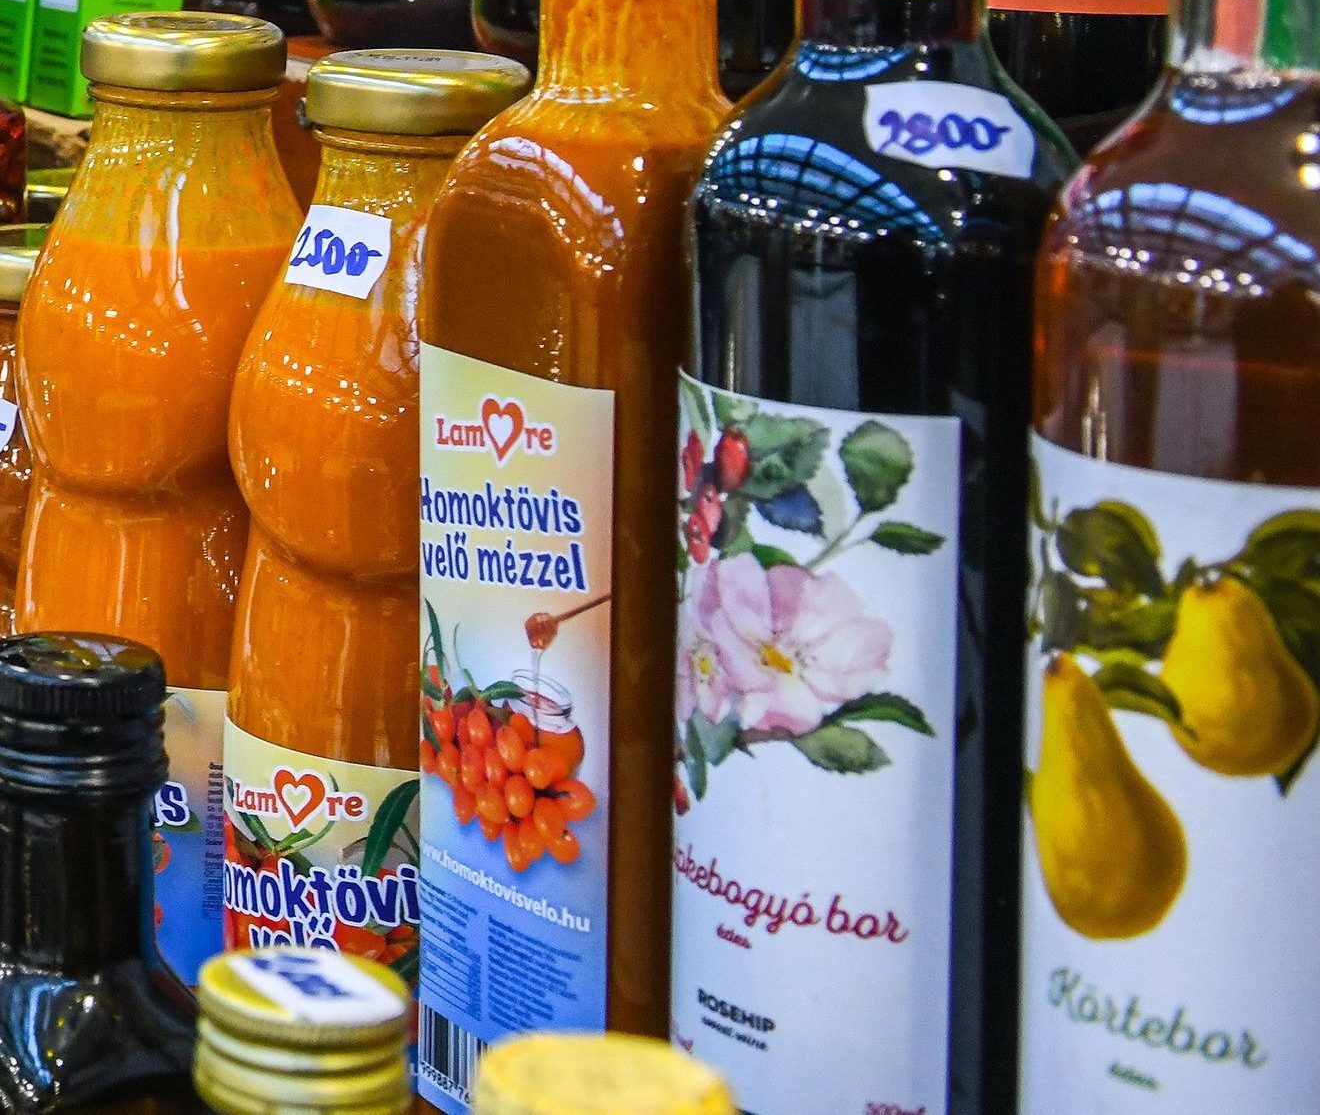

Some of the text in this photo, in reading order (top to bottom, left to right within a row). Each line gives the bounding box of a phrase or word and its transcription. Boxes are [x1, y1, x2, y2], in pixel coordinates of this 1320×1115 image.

[289, 225, 383, 276] 2500-
[421, 477, 581, 535] Homoktövis
[477, 539, 586, 591] mézzel
[826, 893, 910, 944] bor
[697, 987, 776, 1034] ROSEHIP
